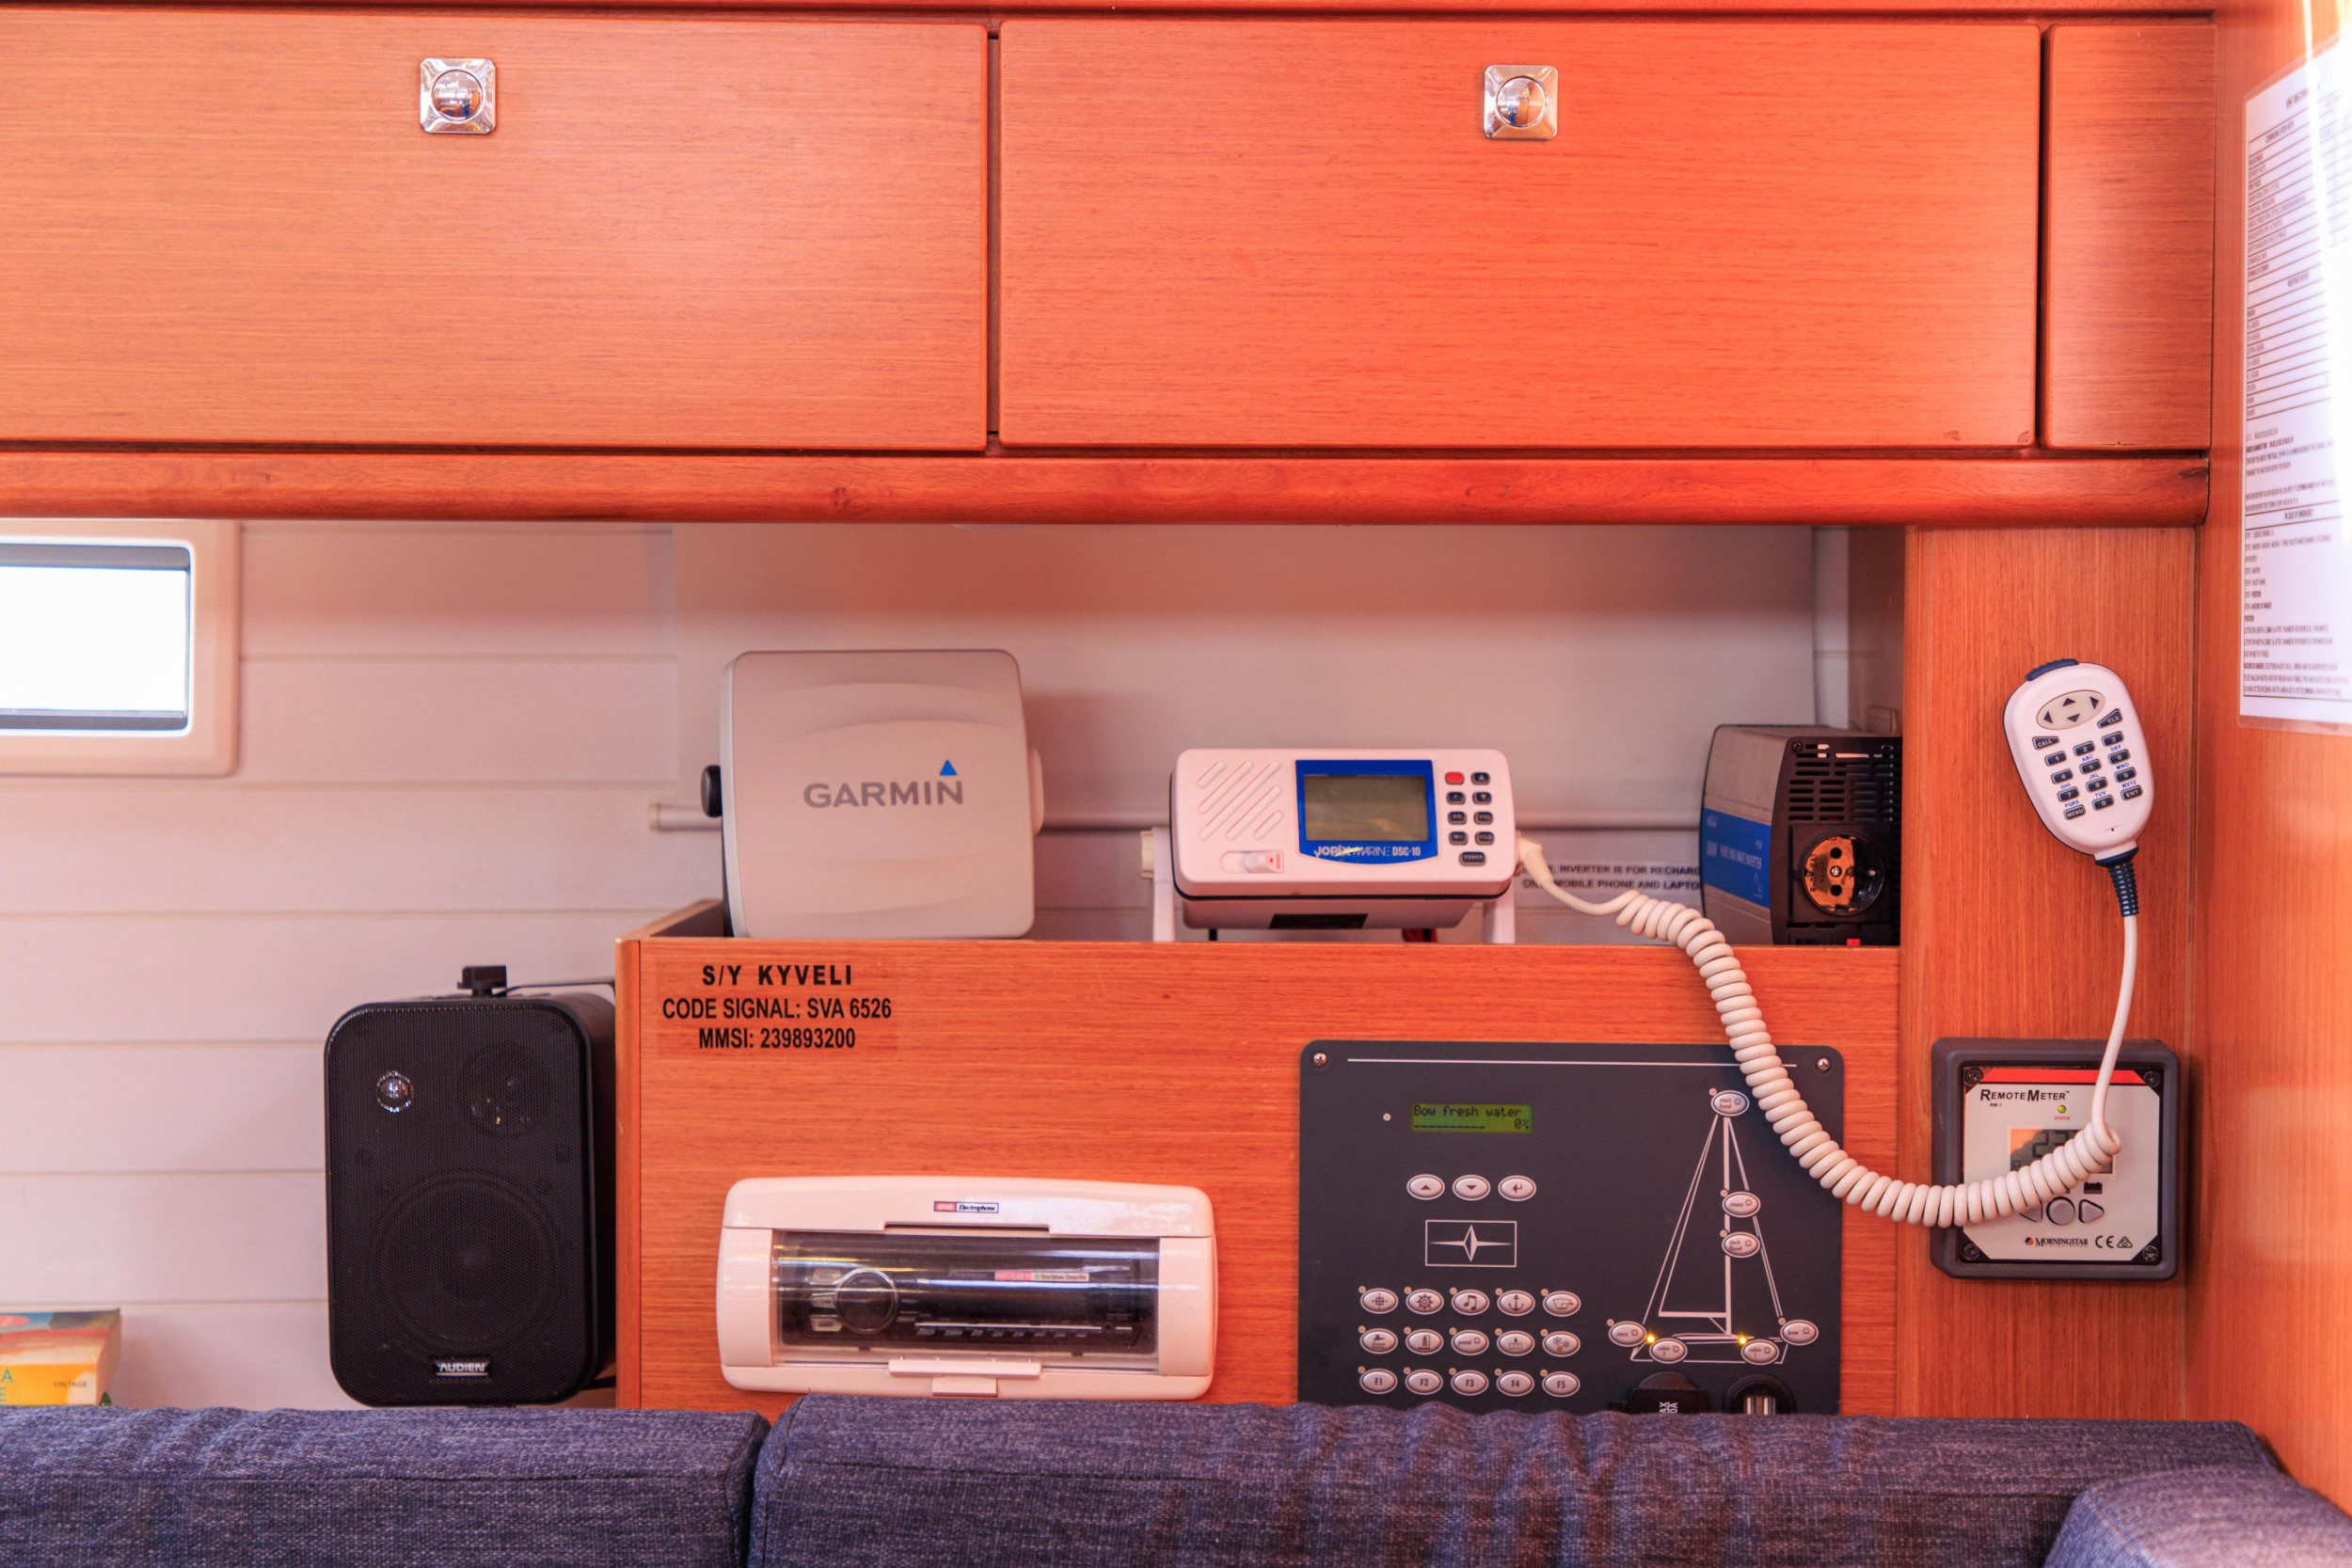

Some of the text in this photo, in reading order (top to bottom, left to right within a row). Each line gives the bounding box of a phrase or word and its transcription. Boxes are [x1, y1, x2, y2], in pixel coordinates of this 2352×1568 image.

[2107, 715, 2121, 723] CLR
[2037, 739, 2053, 748] CALL
[2116, 762, 2129, 770] MNO
[2122, 780, 2137, 788] WXYZ
[803, 781, 963, 809] GARMIN
[2064, 800, 2079, 808] PQRS
[2066, 809, 2084, 817] MENU
[1353, 847, 1391, 856] MARINE
[1392, 847, 1421, 856] DSC-10
[1560, 865, 1610, 874] INVERTER
[1613, 865, 1623, 874] IS
[1627, 865, 1647, 874] FOR
[1554, 879, 1594, 888] MOBILE
[1597, 879, 1634, 888] PHONE
[1638, 880, 1661, 889] AND
[1663, 880, 1700, 891] LAPTO
[702, 964, 852, 987] S/Y KYVELI
[662, 997, 892, 1020] CODE SIGNAL: SVA 6526
[699, 1027, 855, 1049] MMSI: 239893200
[1413, 1105, 1522, 1117] Bow fresh water
[1515, 1118, 1529, 1130] 0%
[959, 1204, 995, 1212] Electrophone
[2035, 1237, 2089, 1246] MORNINGSTAR
[438, 1362, 486, 1372] AUDIEN
[1375, 1377, 1383, 1386] F1
[1420, 1378, 1429, 1386] F2
[1466, 1379, 1474, 1387] F3
[1511, 1379, 1520, 1388] F4
[1557, 1380, 1565, 1389] F5
